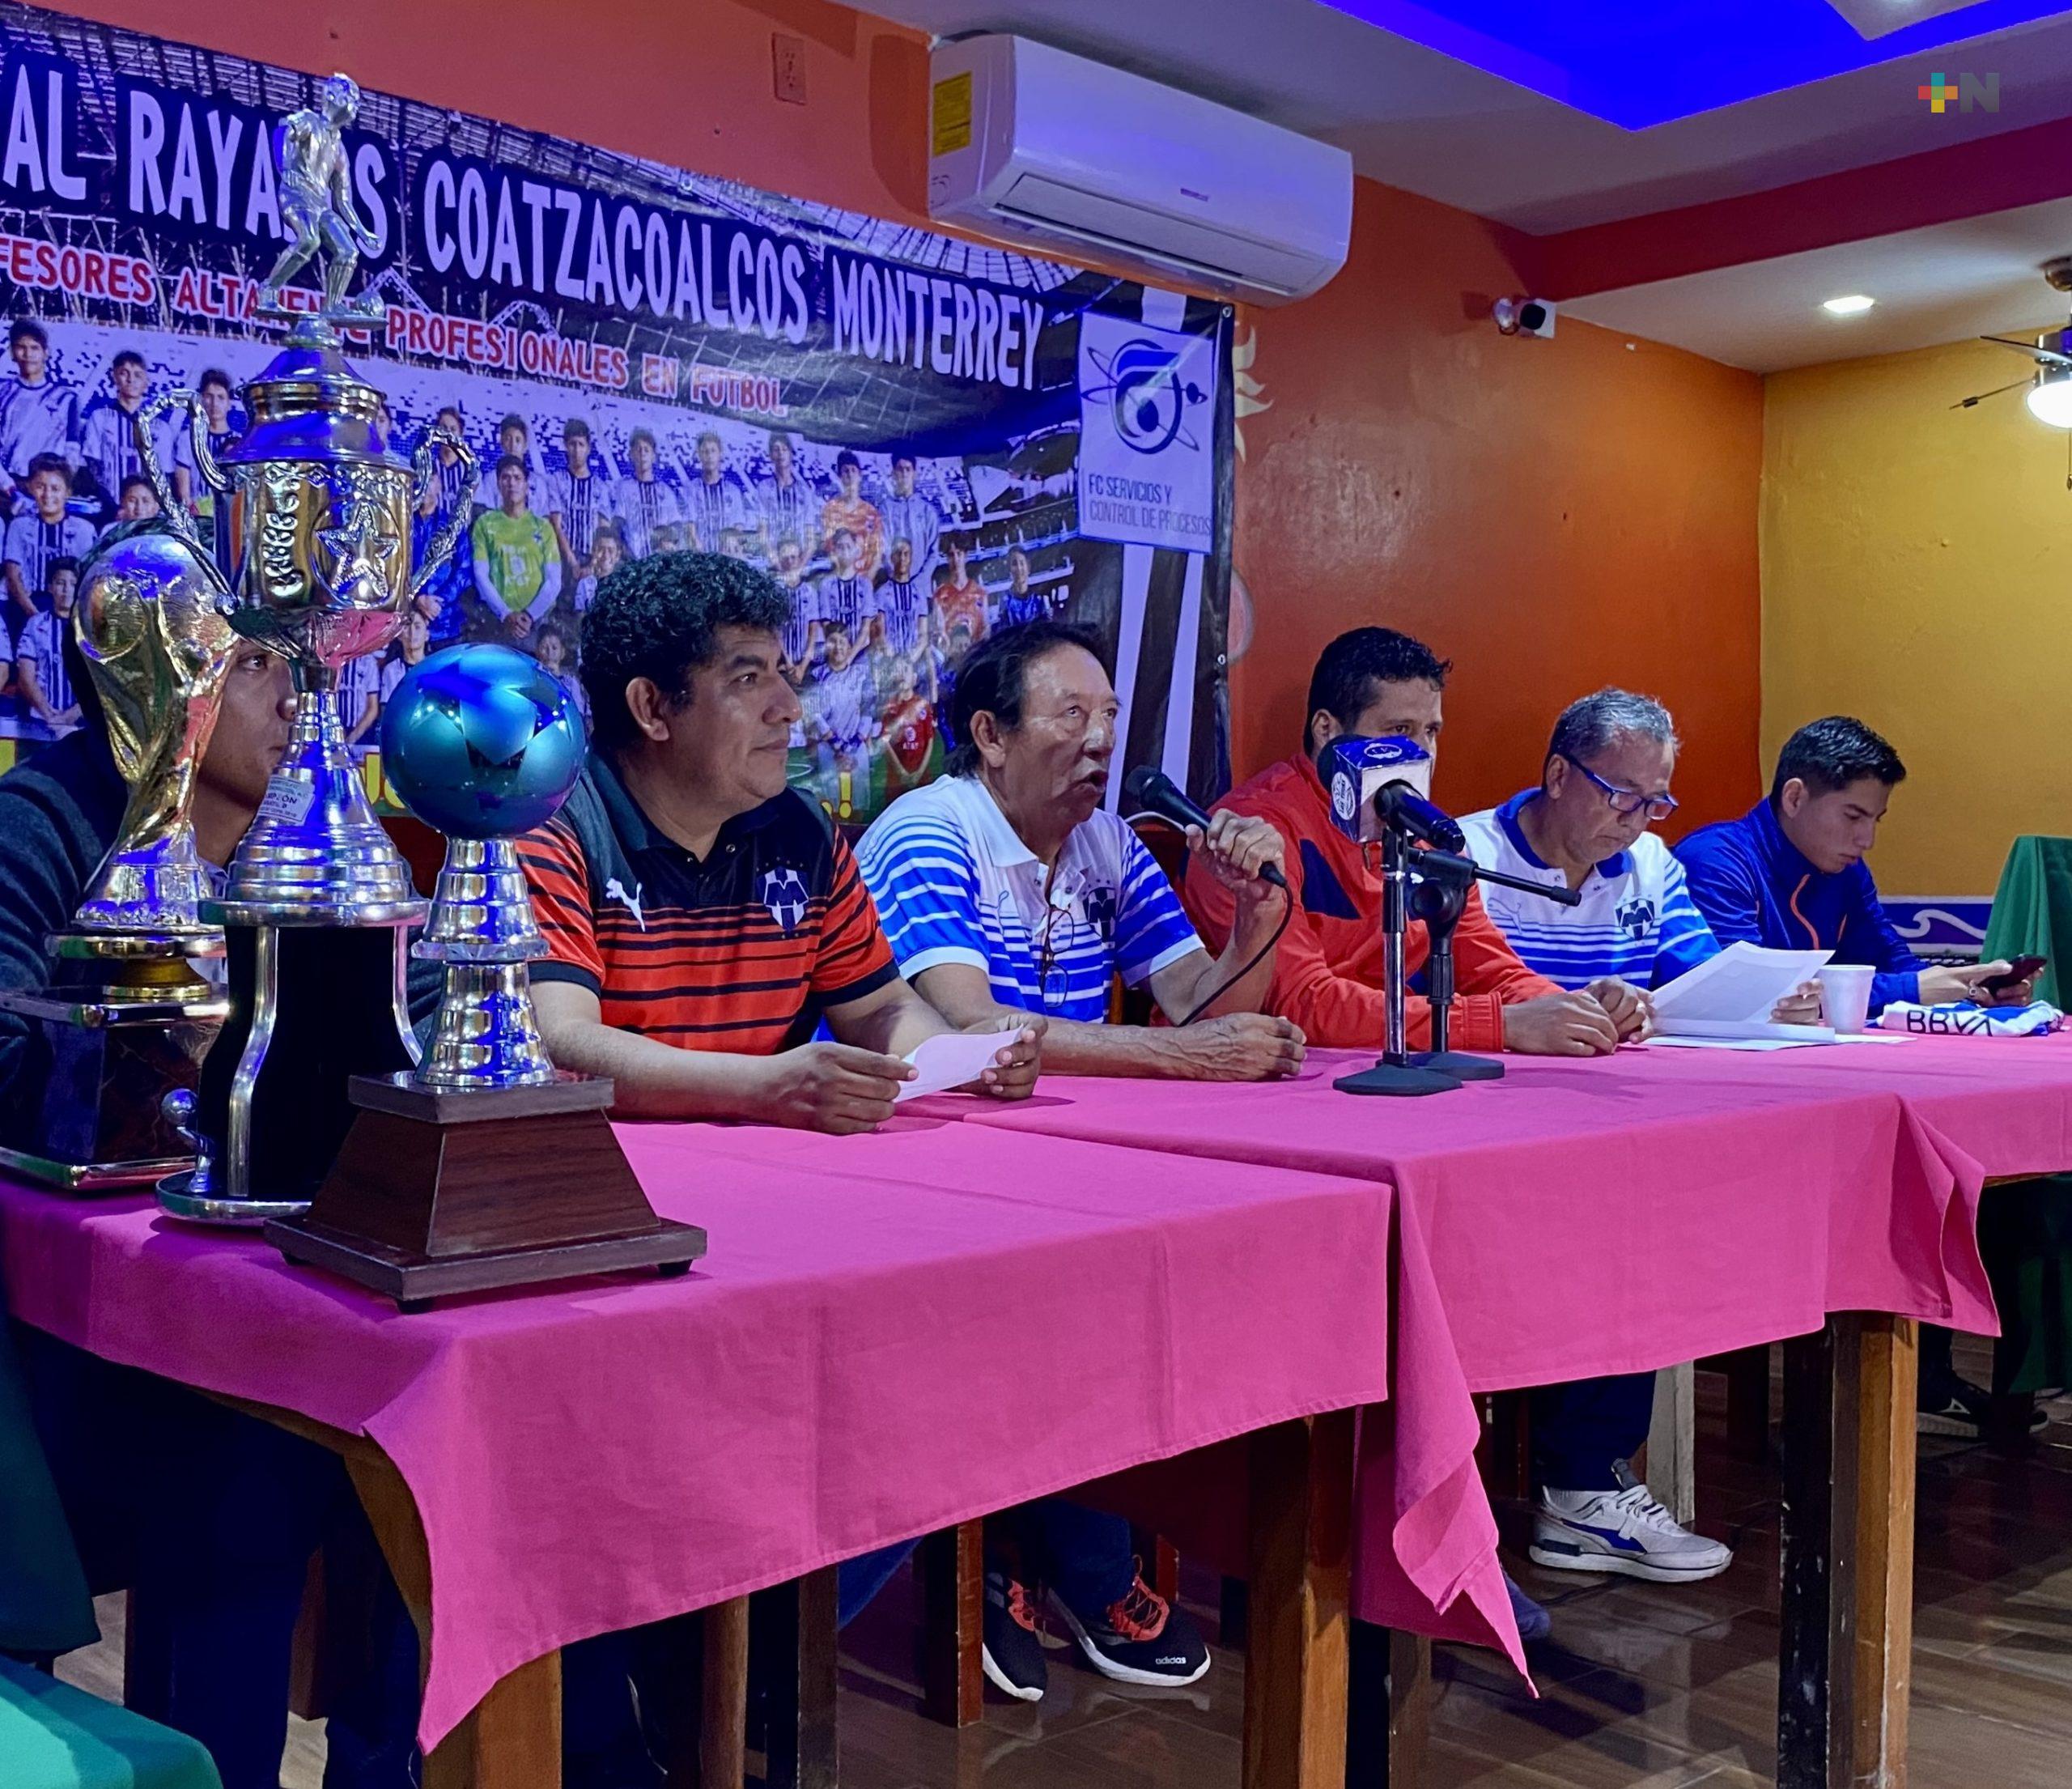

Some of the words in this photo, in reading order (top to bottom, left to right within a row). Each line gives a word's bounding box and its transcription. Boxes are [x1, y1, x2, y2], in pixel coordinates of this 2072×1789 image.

[2, 64, 87, 201] AL
[130, 90, 388, 259] RAYAS
[424, 160, 809, 344] COATZACOALCOS
[833, 255, 1044, 390] MONTERREY
[386, 306, 630, 389] PROFESIONALES
[643, 354, 679, 398] EN
[691, 363, 788, 417] FUTBOL
[1089, 474, 1104, 495] FC
[1106, 477, 1161, 504] SERVICIOS
[1165, 487, 1173, 505] Y
[1089, 500, 1138, 525] CONTROL
[1141, 508, 1157, 529] DE
[1907, 1009, 1993, 1037] BBVA
[1155, 1656, 1187, 1664] adidas
